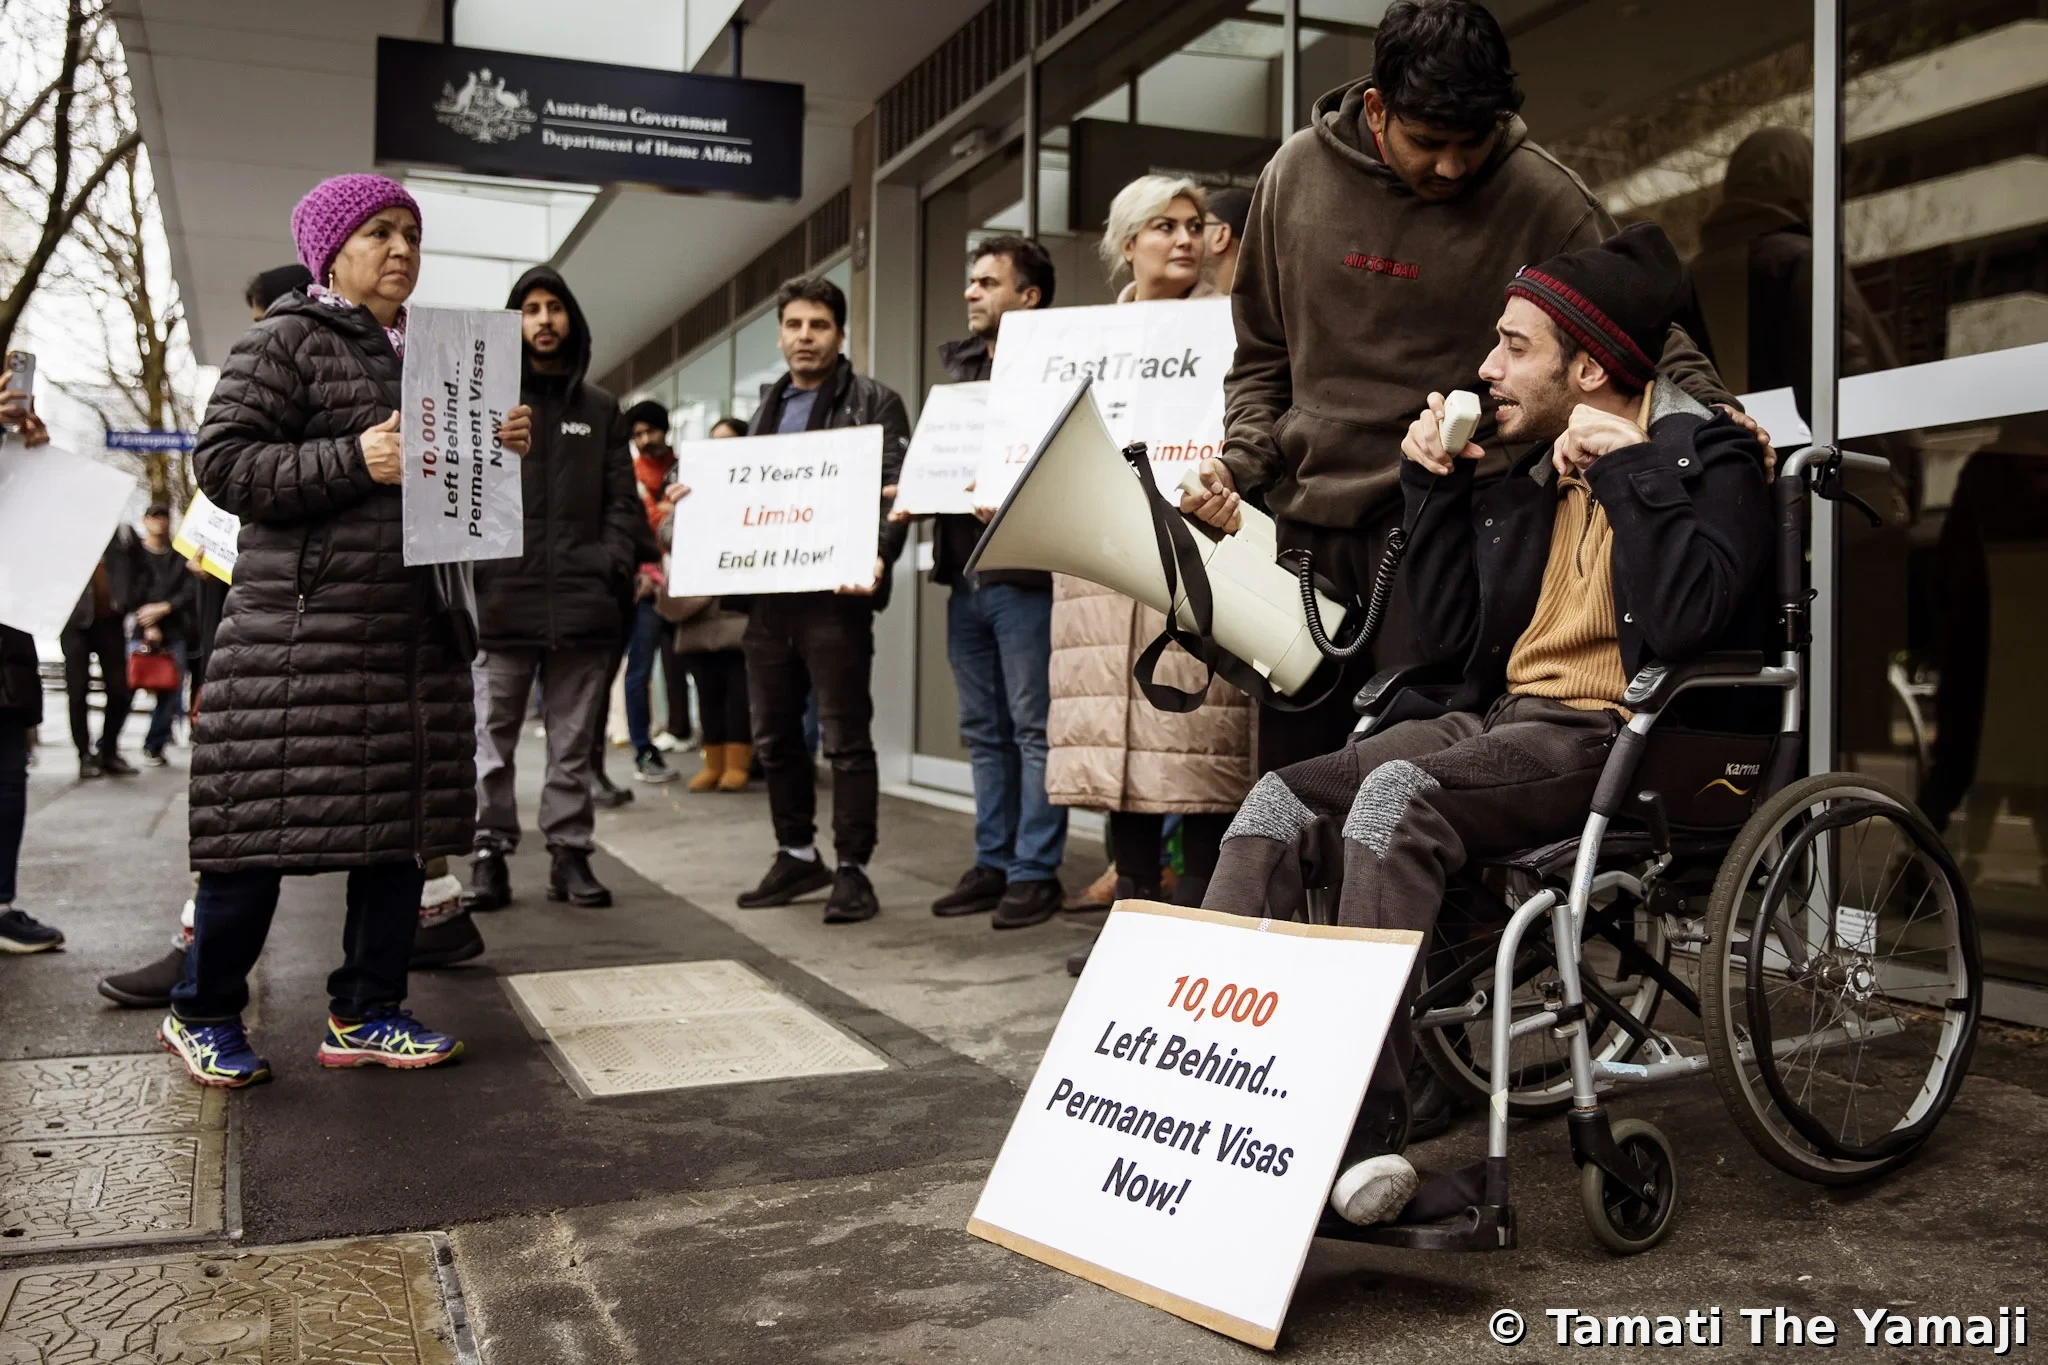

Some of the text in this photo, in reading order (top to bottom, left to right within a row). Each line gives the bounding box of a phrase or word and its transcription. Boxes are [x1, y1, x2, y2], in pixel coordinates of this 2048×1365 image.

[543, 98, 728, 133] Australian Government
[542, 128, 752, 164] Department of Home Affairs
[1343, 253, 1419, 278] AIR JORDAN
[1041, 348, 1202, 384] FastTrack
[422, 396, 441, 479] 10,000
[444, 361, 461, 518] Left Behind...
[468, 339, 486, 538] Permanent Visas
[489, 410, 502, 467] Now!
[1004, 443, 1030, 464] 12
[728, 461, 839, 485] 12 Years In
[743, 504, 814, 527] Limbo
[718, 545, 835, 570] End It Now!
[1724, 762, 1760, 776] Karma
[1167, 974, 1279, 1027] 10,000
[1094, 1021, 1288, 1099] Left Behind...
[1046, 1078, 1294, 1177] Permanent Visas
[1102, 1157, 1192, 1216] Now!
